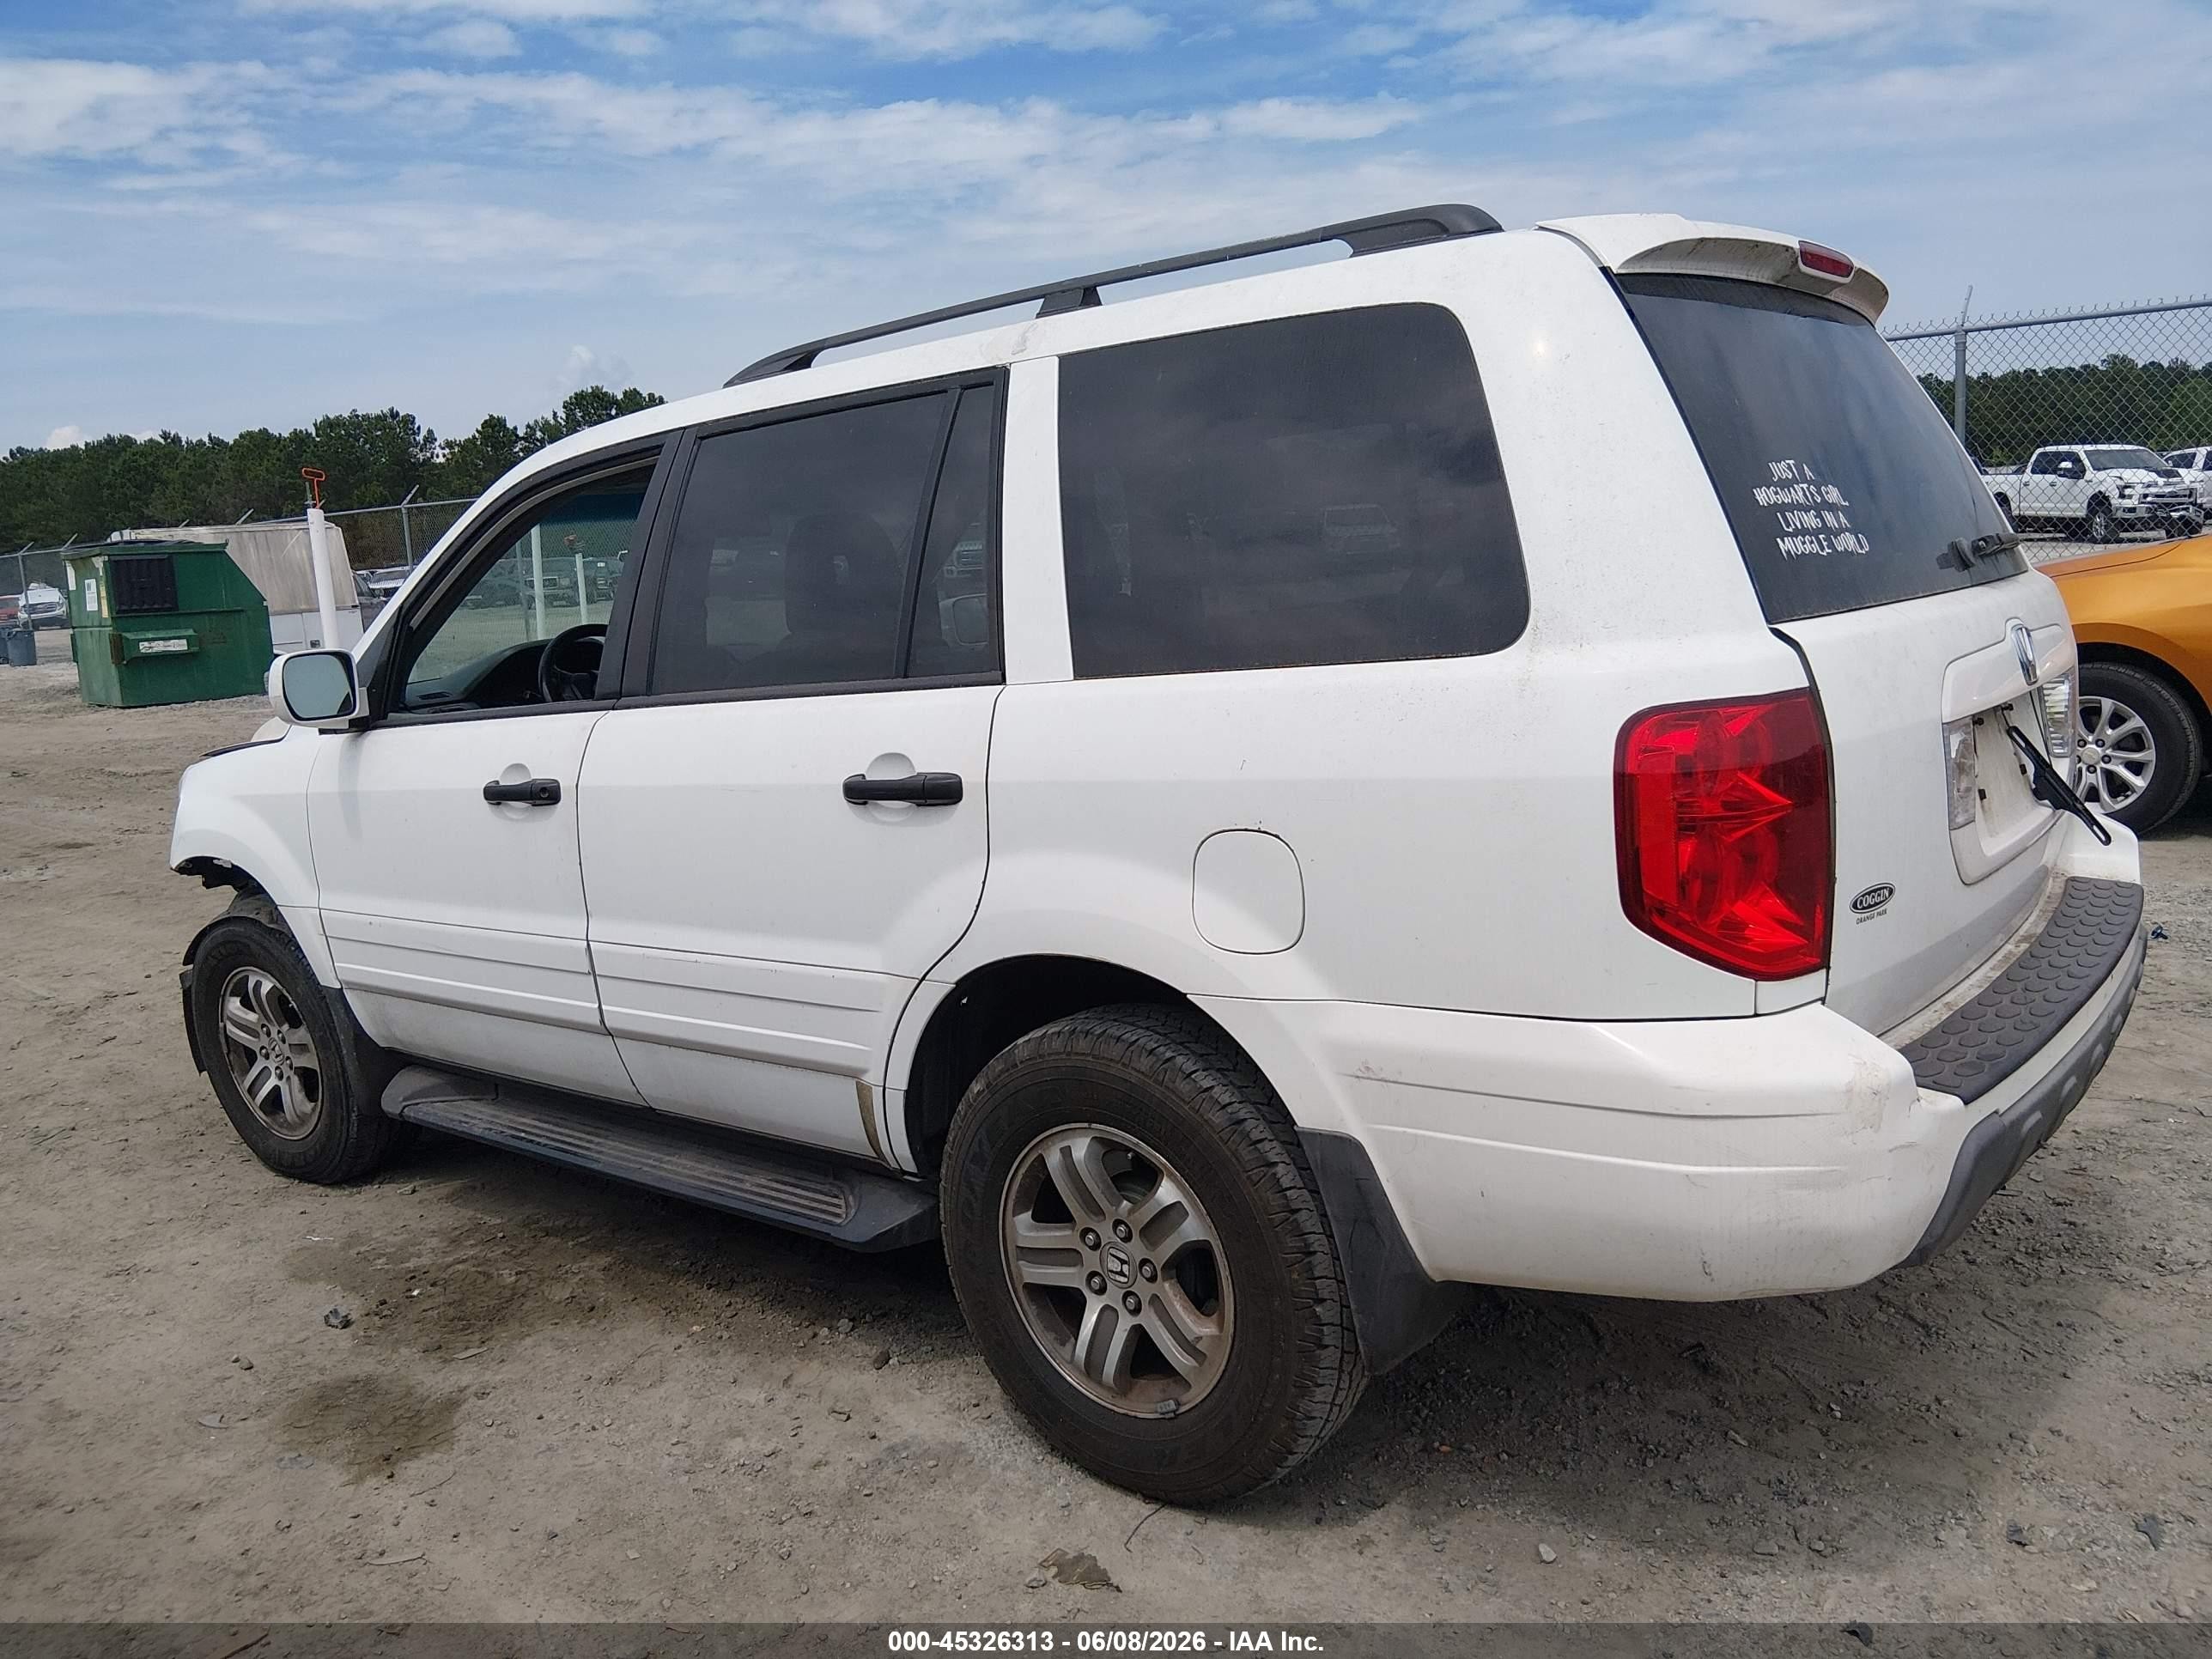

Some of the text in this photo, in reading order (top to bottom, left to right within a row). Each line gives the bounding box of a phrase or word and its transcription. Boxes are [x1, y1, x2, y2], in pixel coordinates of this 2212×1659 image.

[1768, 459, 1815, 482] JUST A
[1753, 483, 1850, 507] HOGWARTS GIRL
[1777, 509, 1851, 532] LIVING IN A
[1776, 532, 1869, 560] MUGGLE WORLD
[1856, 887, 1890, 909] COGGIN
